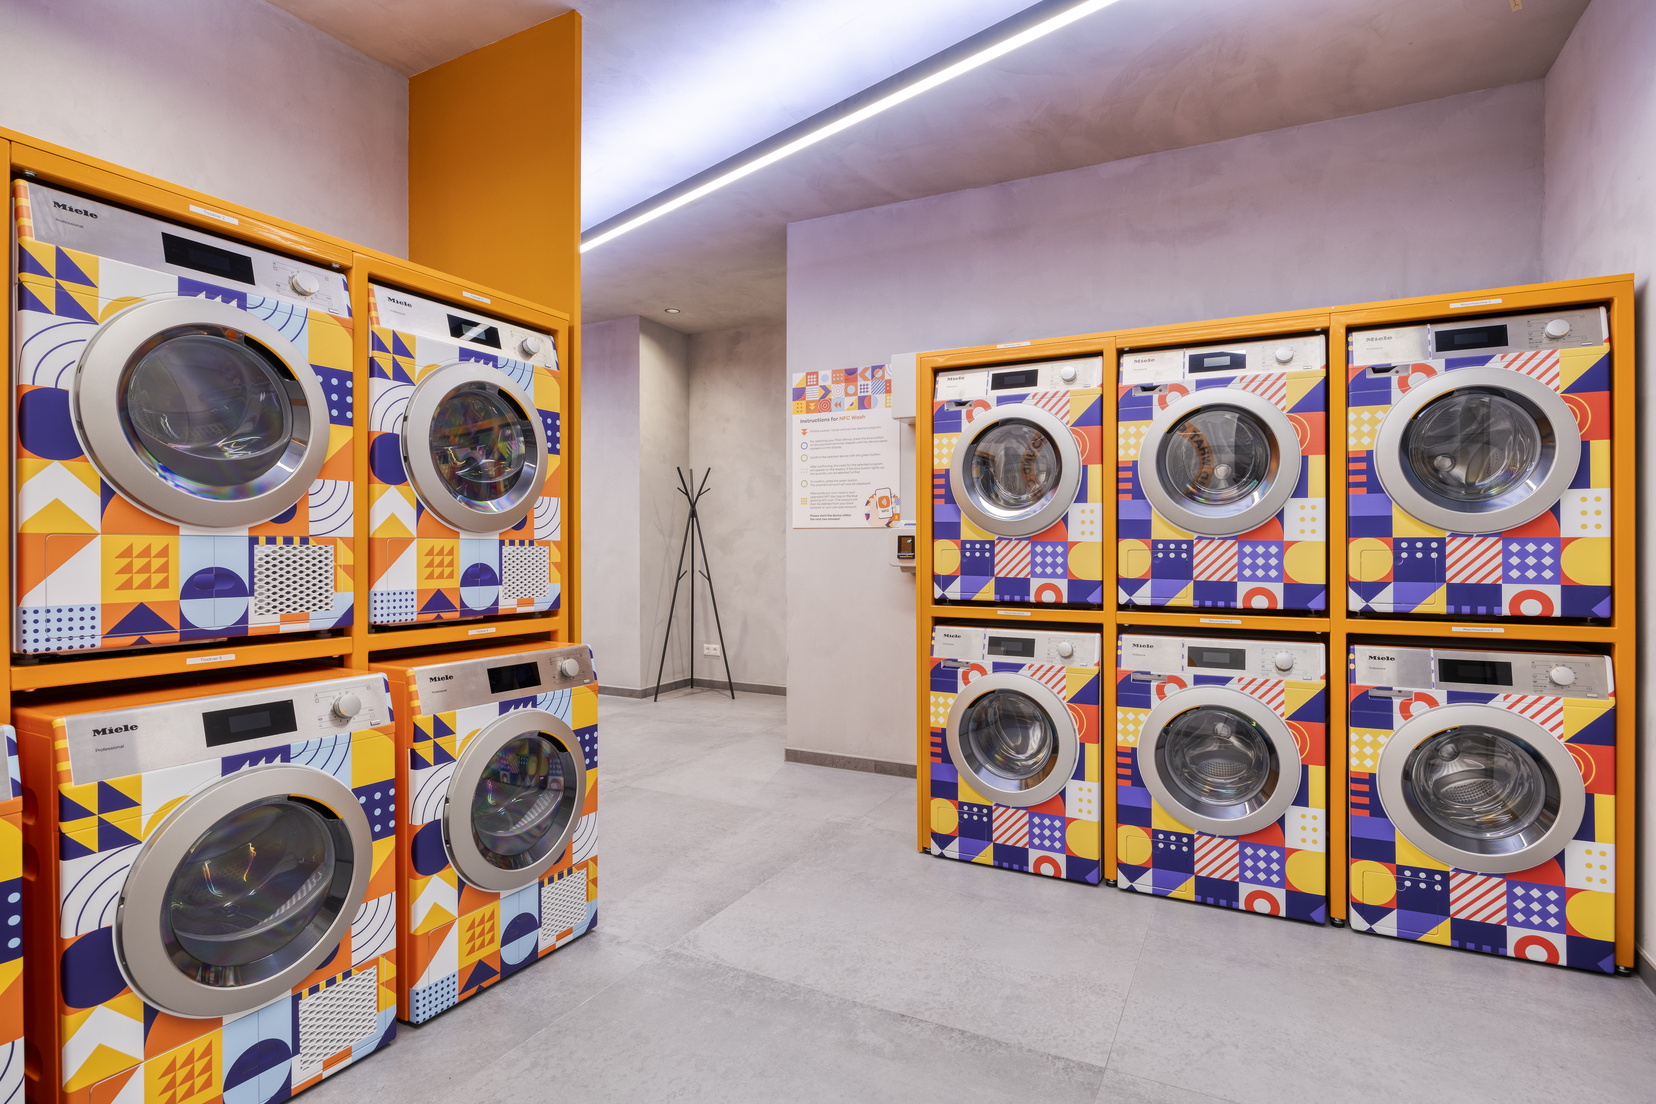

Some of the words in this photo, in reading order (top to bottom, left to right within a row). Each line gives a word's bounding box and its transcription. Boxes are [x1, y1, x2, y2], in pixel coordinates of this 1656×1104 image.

[53, 200, 98, 219] Miele
[387, 296, 412, 308] Miele
[429, 674, 454, 683] Miele
[92, 724, 138, 737] Miele
[95, 744, 124, 752] Professional
